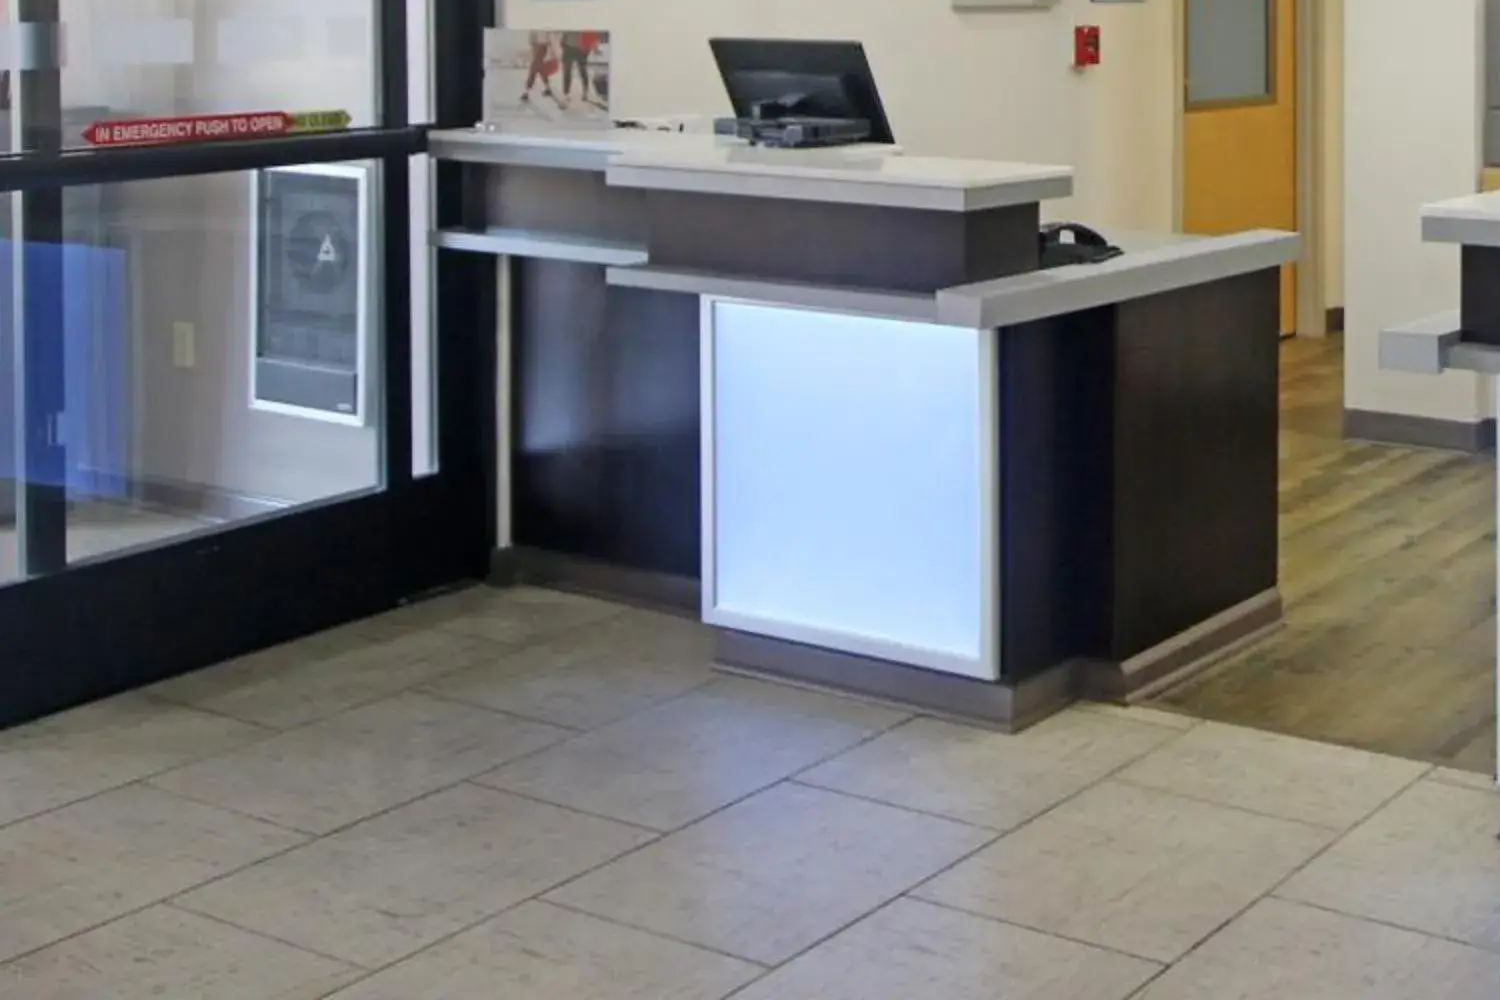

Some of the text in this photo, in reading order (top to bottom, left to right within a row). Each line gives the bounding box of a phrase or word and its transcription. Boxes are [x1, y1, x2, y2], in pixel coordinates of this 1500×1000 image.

[95, 126, 110, 142] IN
[113, 121, 192, 141] EMERGENCY
[195, 117, 229, 136] PUSH
[231, 117, 248, 133] TO
[250, 114, 283, 132] OPEN
